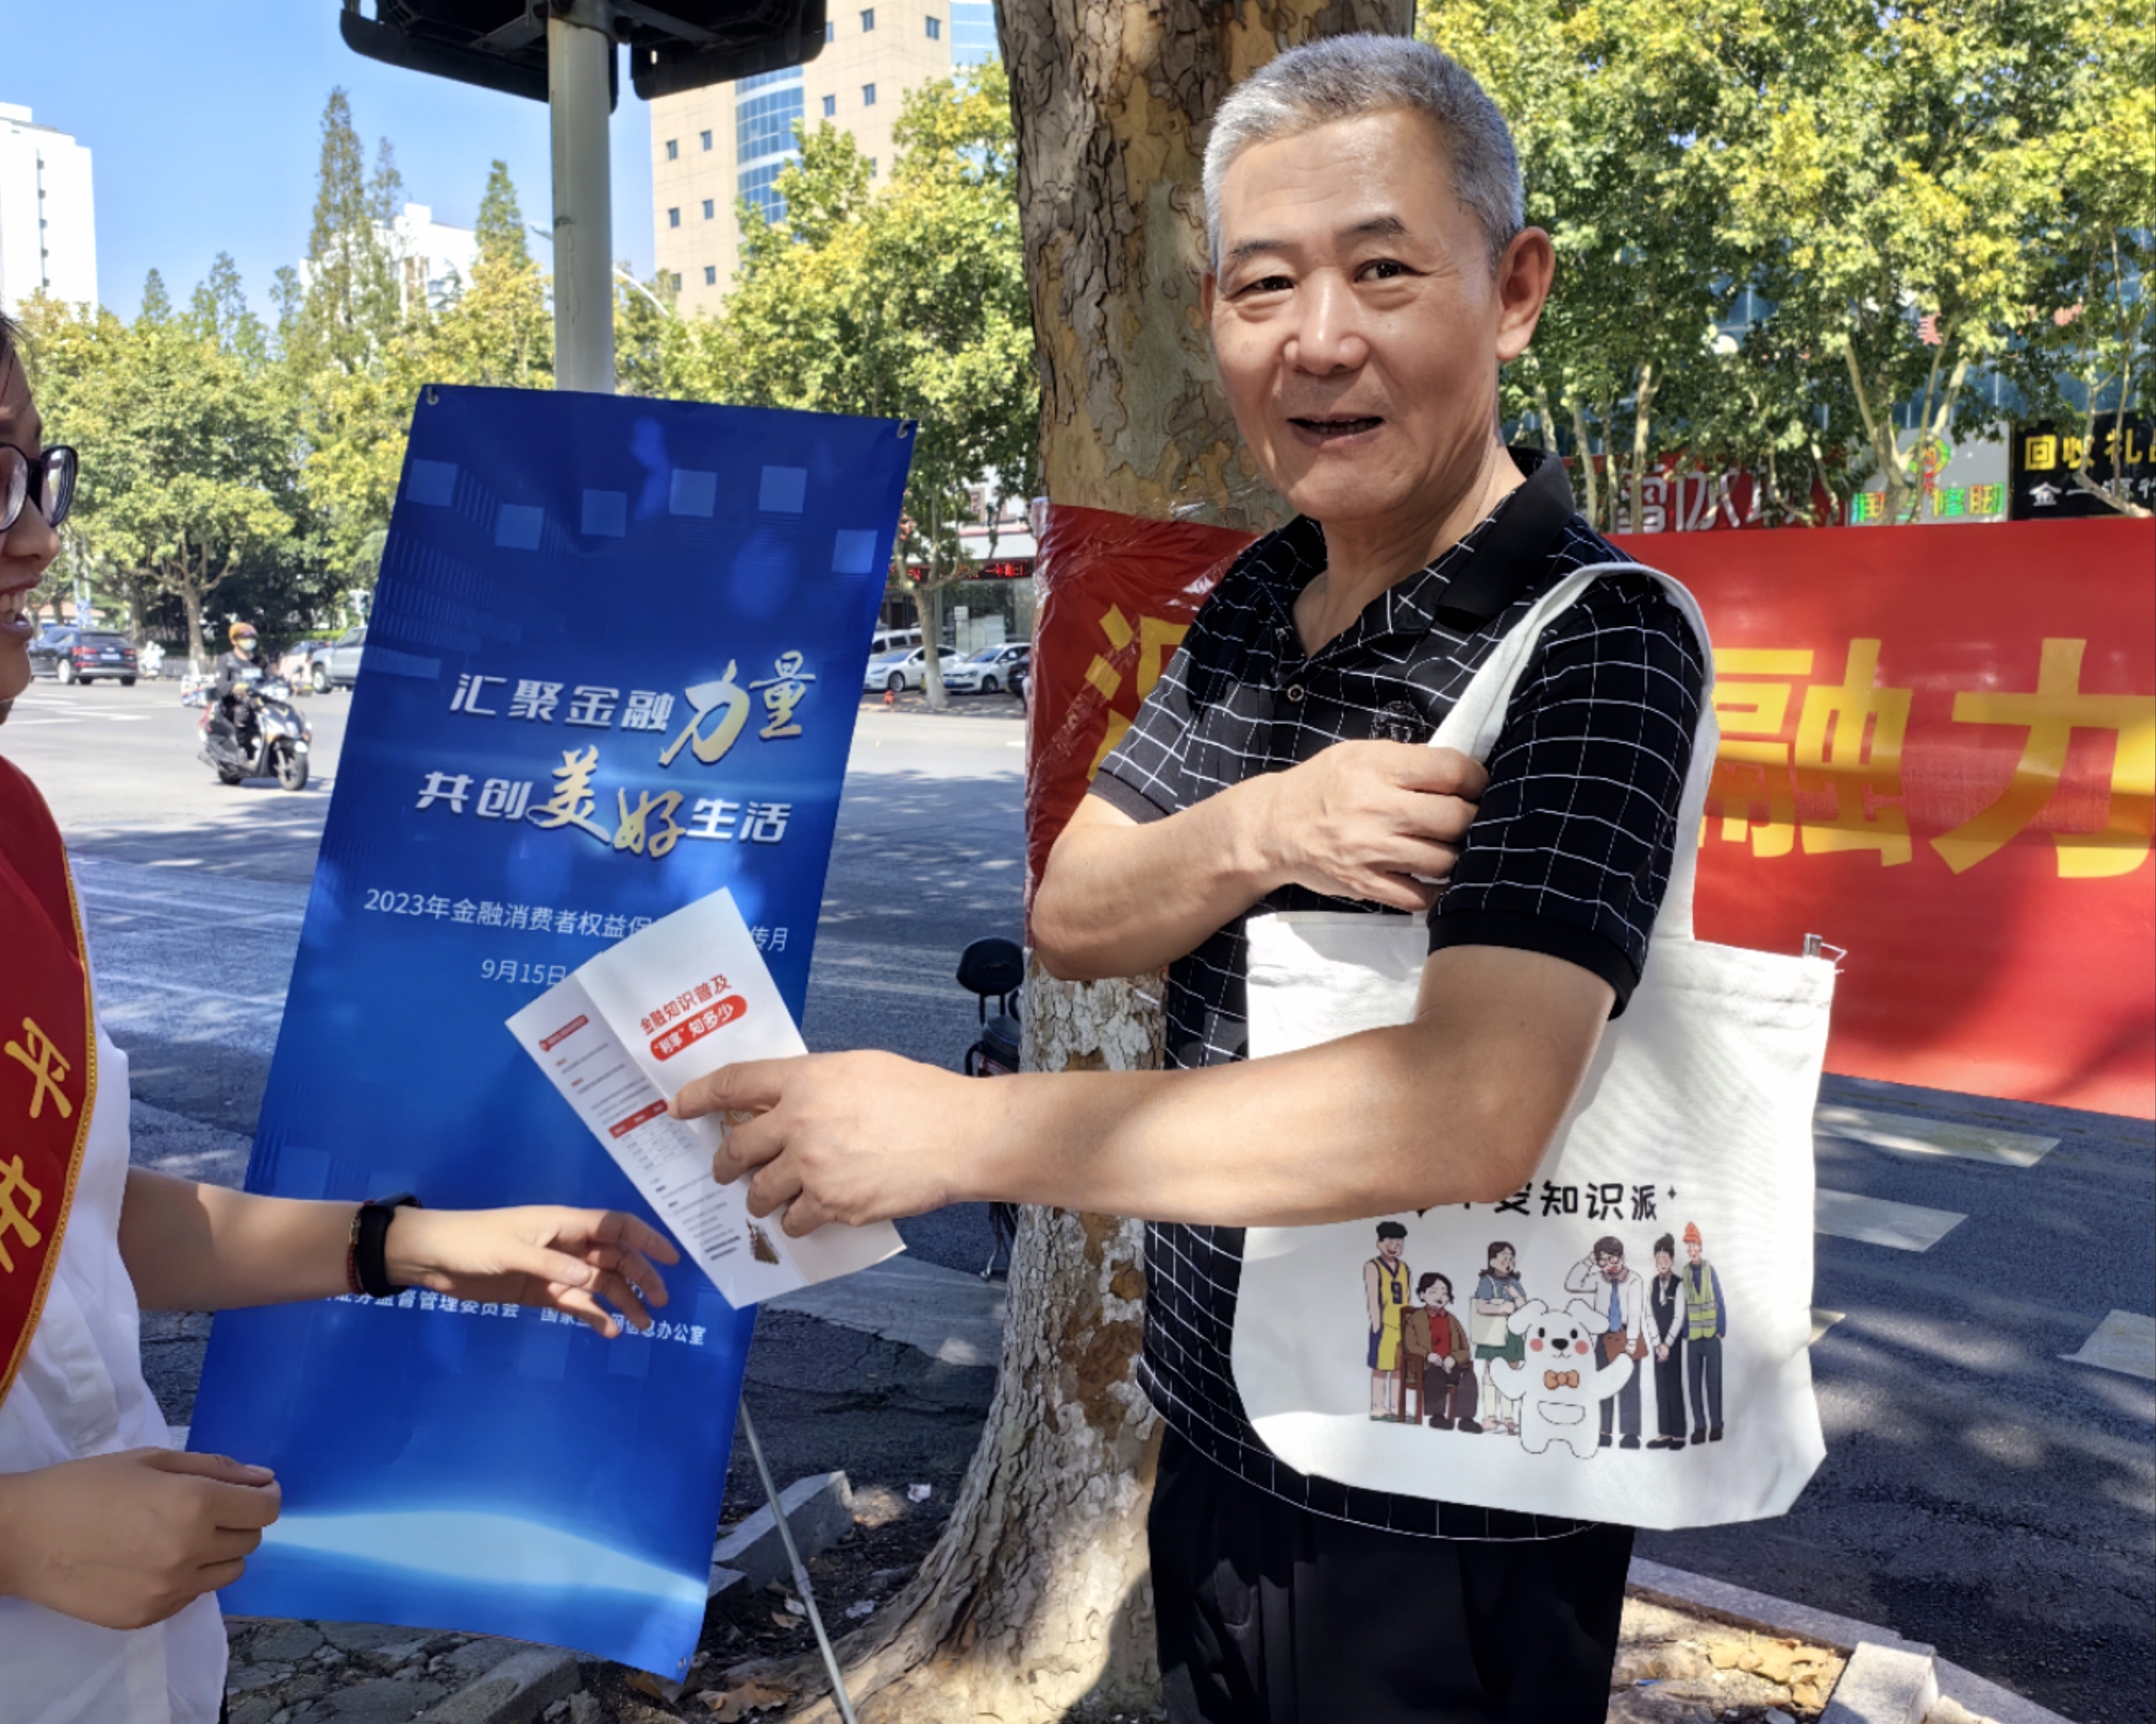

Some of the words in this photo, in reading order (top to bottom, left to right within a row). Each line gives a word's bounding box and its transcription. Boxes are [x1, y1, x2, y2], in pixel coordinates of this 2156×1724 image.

[2025, 428, 2156, 471] 回收礼
[1851, 483, 2003, 522] 润修脚
[449, 650, 817, 767] 汇聚金融力量
[414, 745, 794, 858] 共创美好生活
[364, 888, 789, 952] 2023年金融消费者权益保传月
[640, 973, 732, 1035] 金融知识普及
[540, 1306, 707, 1346] 国家网信息办公室
